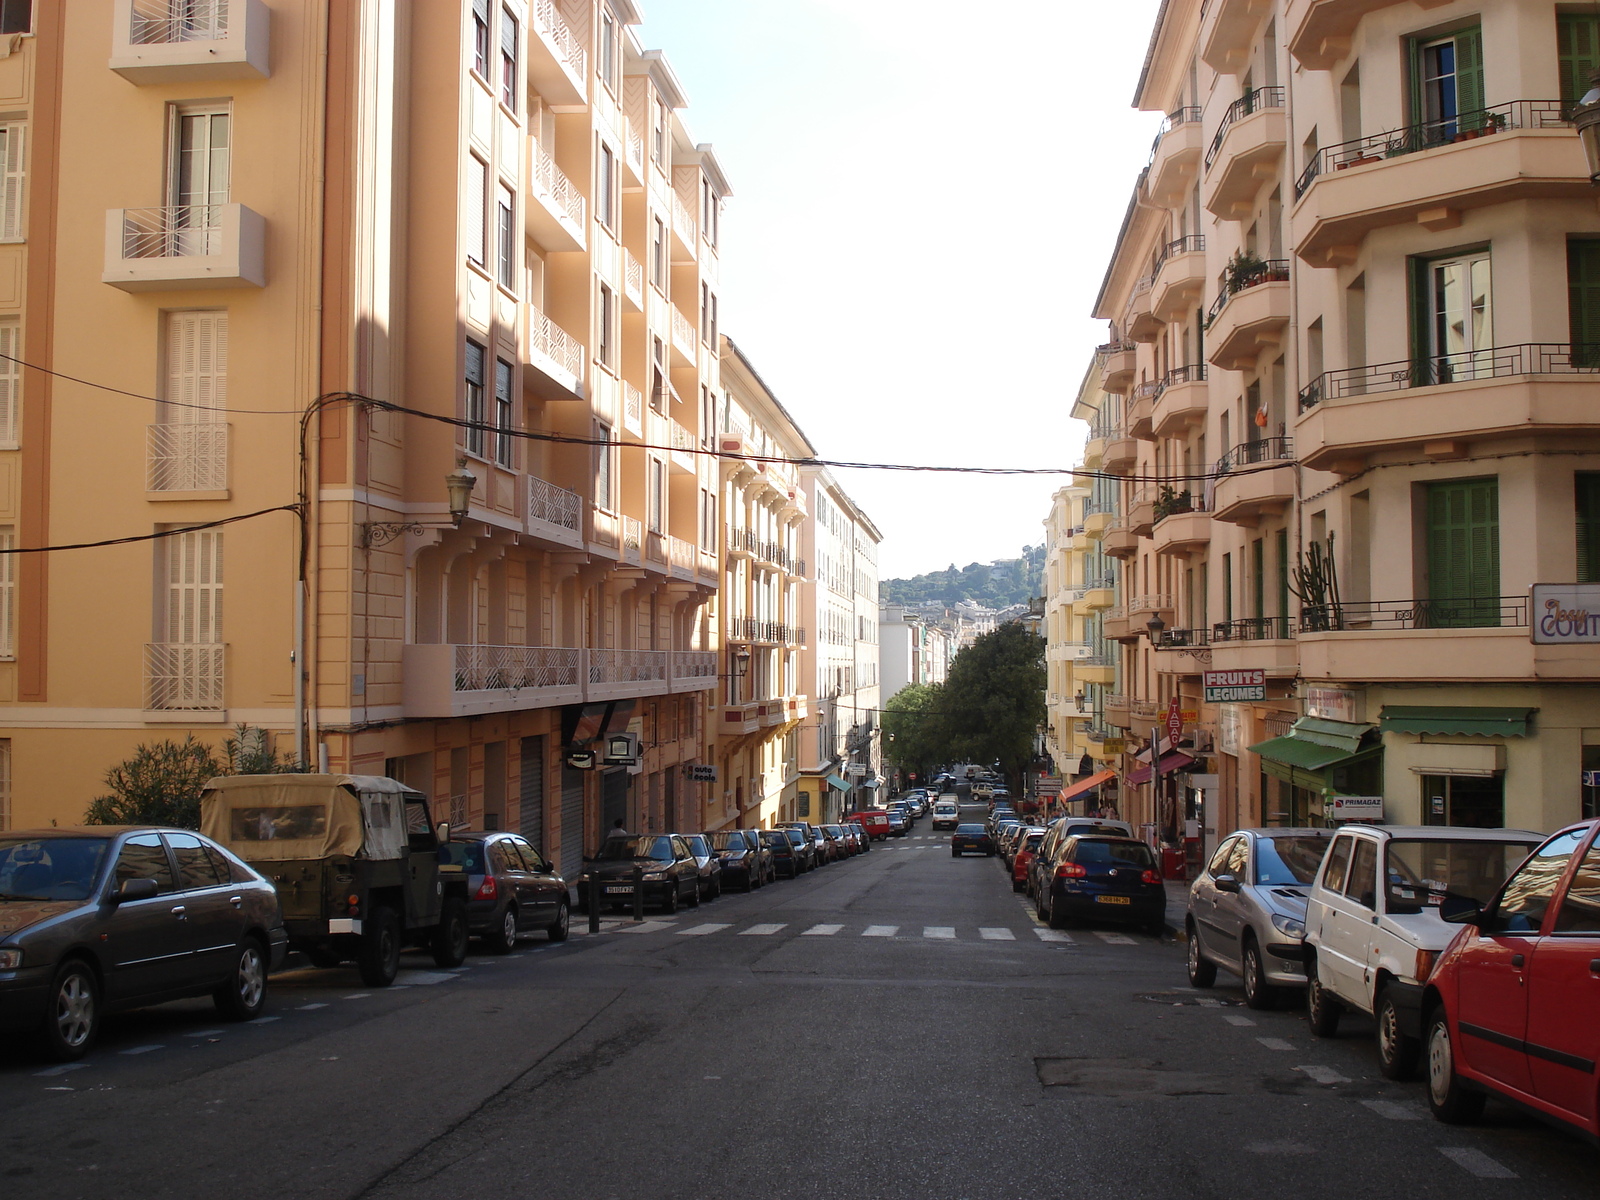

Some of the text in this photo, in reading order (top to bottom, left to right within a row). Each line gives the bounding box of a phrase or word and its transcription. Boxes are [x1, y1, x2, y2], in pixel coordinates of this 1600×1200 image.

[1545, 599, 1589, 631] Josy
[1206, 671, 1264, 686] FRUITS
[1206, 686, 1264, 701] LEGUMES
[1169, 704, 1181, 744] TABAC
